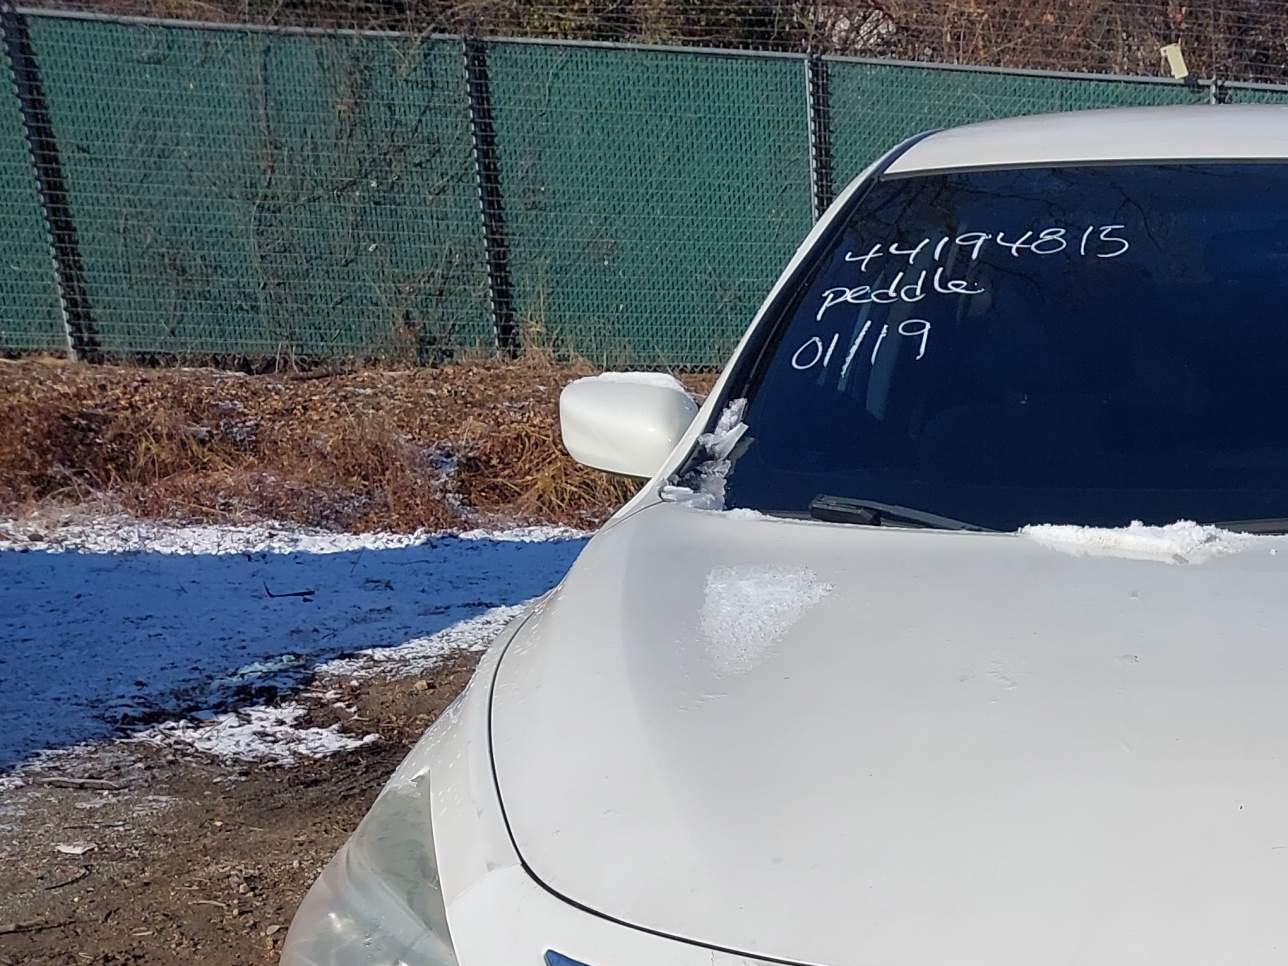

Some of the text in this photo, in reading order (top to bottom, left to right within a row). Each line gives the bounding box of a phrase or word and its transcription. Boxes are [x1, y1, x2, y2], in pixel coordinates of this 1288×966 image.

[844, 224, 1131, 272] 44194815
[817, 267, 984, 321] peddle
[791, 318, 932, 378] 01/19
